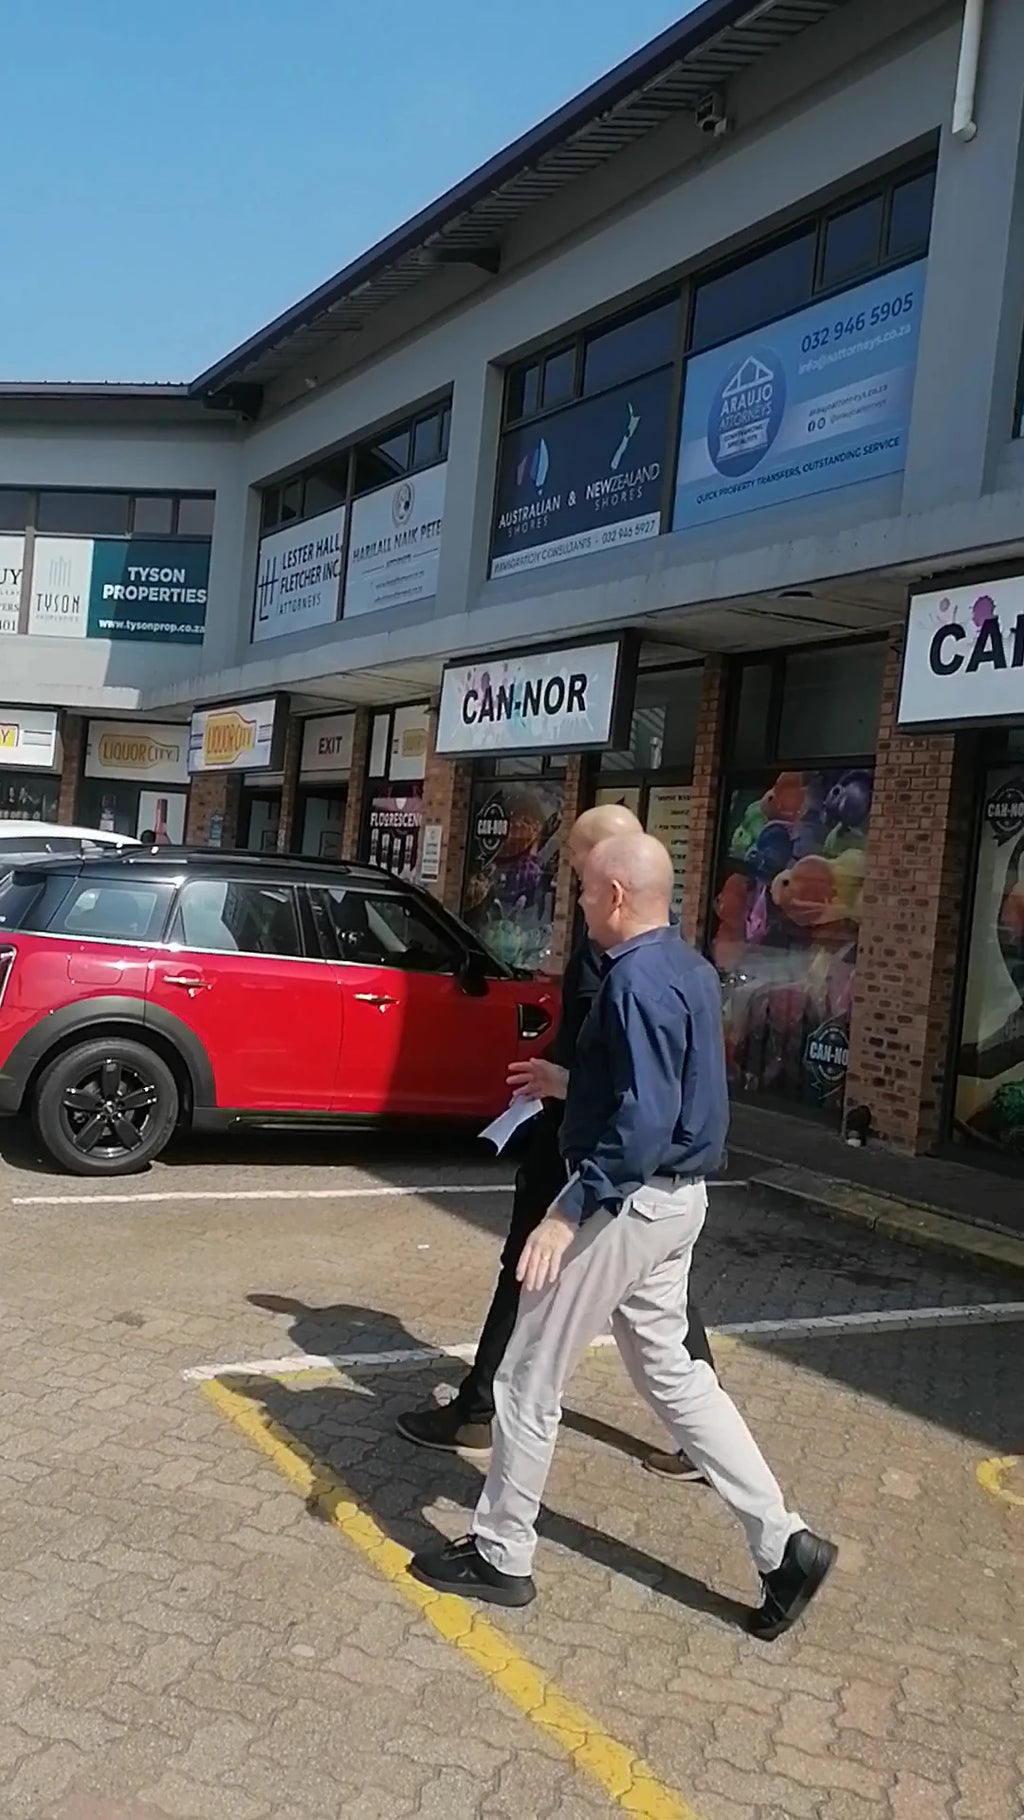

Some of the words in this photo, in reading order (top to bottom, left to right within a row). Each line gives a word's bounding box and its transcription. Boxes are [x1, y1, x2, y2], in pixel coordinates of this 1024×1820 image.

[801, 327, 829, 353] 032
[834, 312, 866, 340] 946
[870, 292, 913, 326] 5905
[721, 384, 773, 416] ARAUJO
[696, 490, 718, 505] QUICK
[719, 479, 756, 497] PROPERTY
[802, 449, 861, 473] OUTSTANDING
[862, 436, 900, 456] SERVICE
[498, 495, 561, 529] AUSTRALIAN
[567, 490, 577, 507] &
[594, 486, 643, 511] SHORES
[507, 515, 548, 538] SHORES
[602, 530, 615, 544] 032
[282, 542, 314, 570] LESTER
[316, 533, 340, 558] HALL
[128, 566, 186, 583] TYSON
[280, 565, 321, 594] FLETCHER
[37, 593, 80, 613] TYSON
[103, 584, 207, 604] PROPERTIES
[277, 593, 321, 615] ATTORNEYS
[98, 619, 205, 634] www.tysonprop.co.za
[462, 673, 588, 725] CAN-NOR
[318, 736, 342, 755] EXIT
